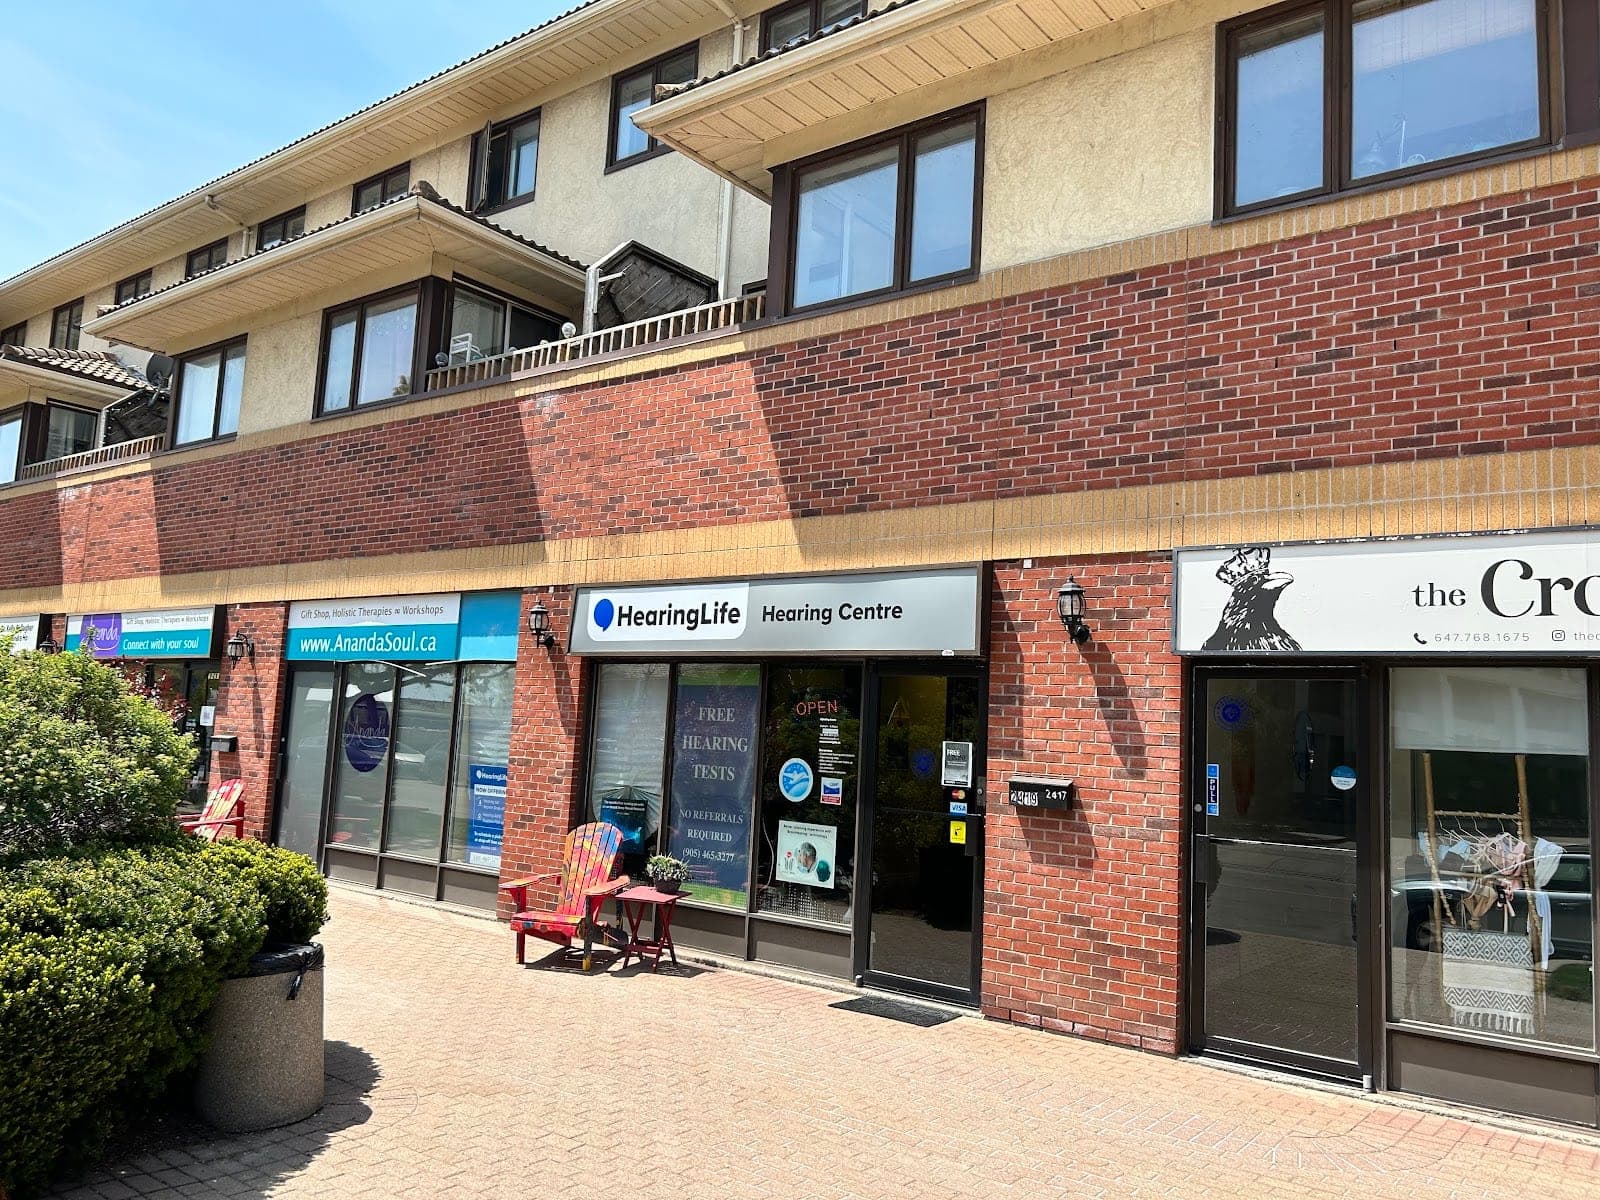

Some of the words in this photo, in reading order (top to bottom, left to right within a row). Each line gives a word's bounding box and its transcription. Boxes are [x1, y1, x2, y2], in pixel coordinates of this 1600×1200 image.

[1412, 583, 1466, 607] the
[300, 610, 313, 619] Gift
[314, 609, 331, 620] Shop,
[332, 607, 357, 617] Holistic
[358, 607, 392, 617] Therapies
[402, 605, 444, 616] Workshops
[617, 602, 741, 631] HearingLife
[762, 604, 833, 625] Hearing
[838, 603, 903, 620] Centre
[123, 639, 149, 650] Connect
[150, 638, 165, 649] with
[166, 640, 182, 652] your
[183, 637, 200, 648] soul
[300, 631, 437, 653] www.AnandaSoul.ca
[1434, 633, 1530, 642] 647.768.1675
[699, 707, 735, 721] FREE
[796, 700, 838, 715] OPEN
[682, 735, 748, 752] HEARING
[482, 771, 506, 781] HearingLif
[692, 764, 735, 781] TESTS
[1045, 789, 1067, 800] 2417
[679, 809, 691, 818] NO
[693, 810, 744, 824] REFERRALS
[687, 829, 732, 842] REQUIRED
[682, 848, 701, 859] (905)
